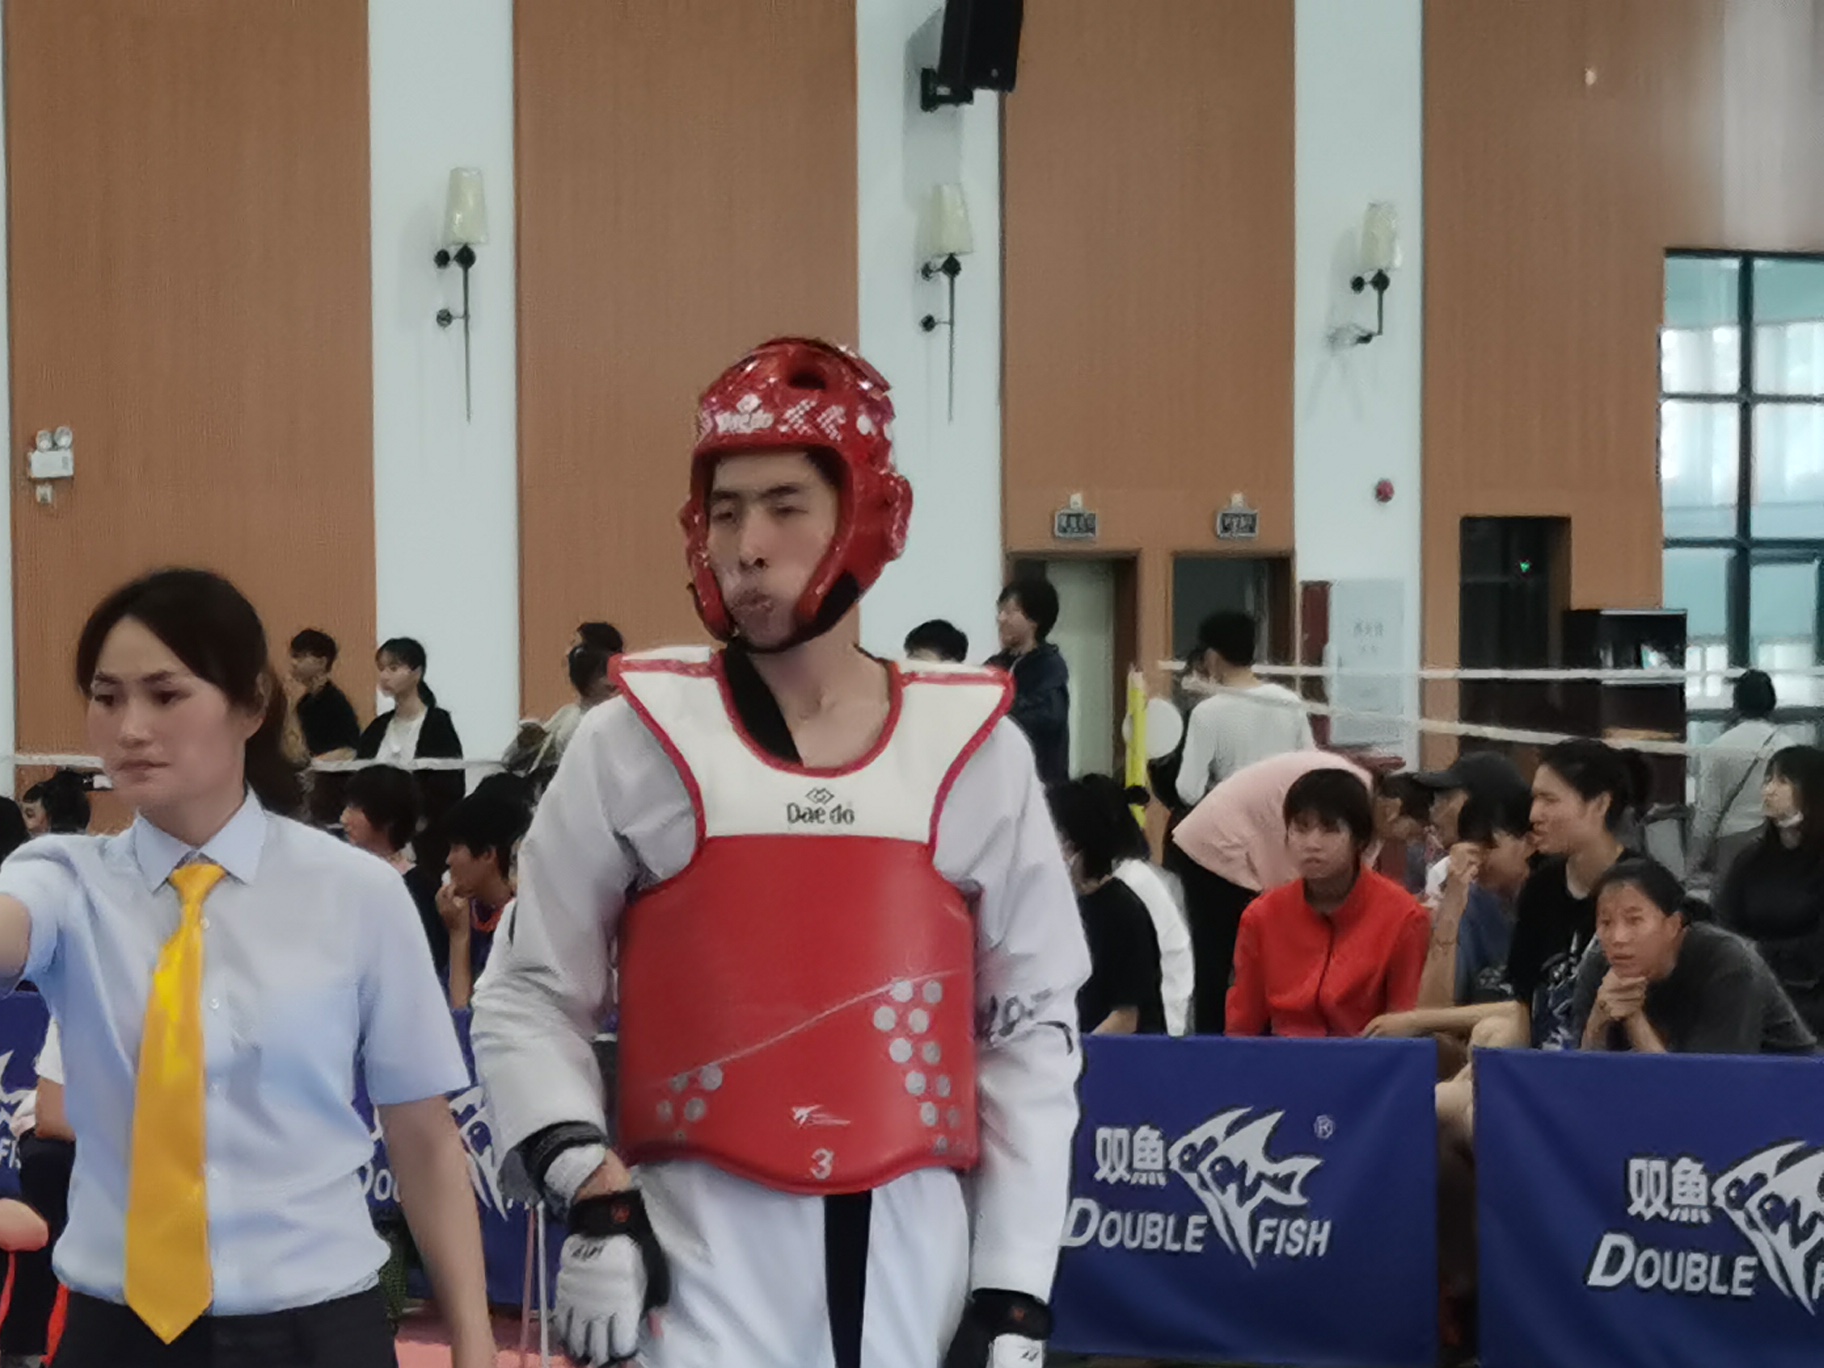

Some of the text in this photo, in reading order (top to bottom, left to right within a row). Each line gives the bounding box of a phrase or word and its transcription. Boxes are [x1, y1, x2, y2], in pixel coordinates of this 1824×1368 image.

[810, 1148, 834, 1180] 3
[1060, 1198, 1331, 1257] DOUBLE FISH
[1587, 1233, 1758, 1296] DOUBLE
